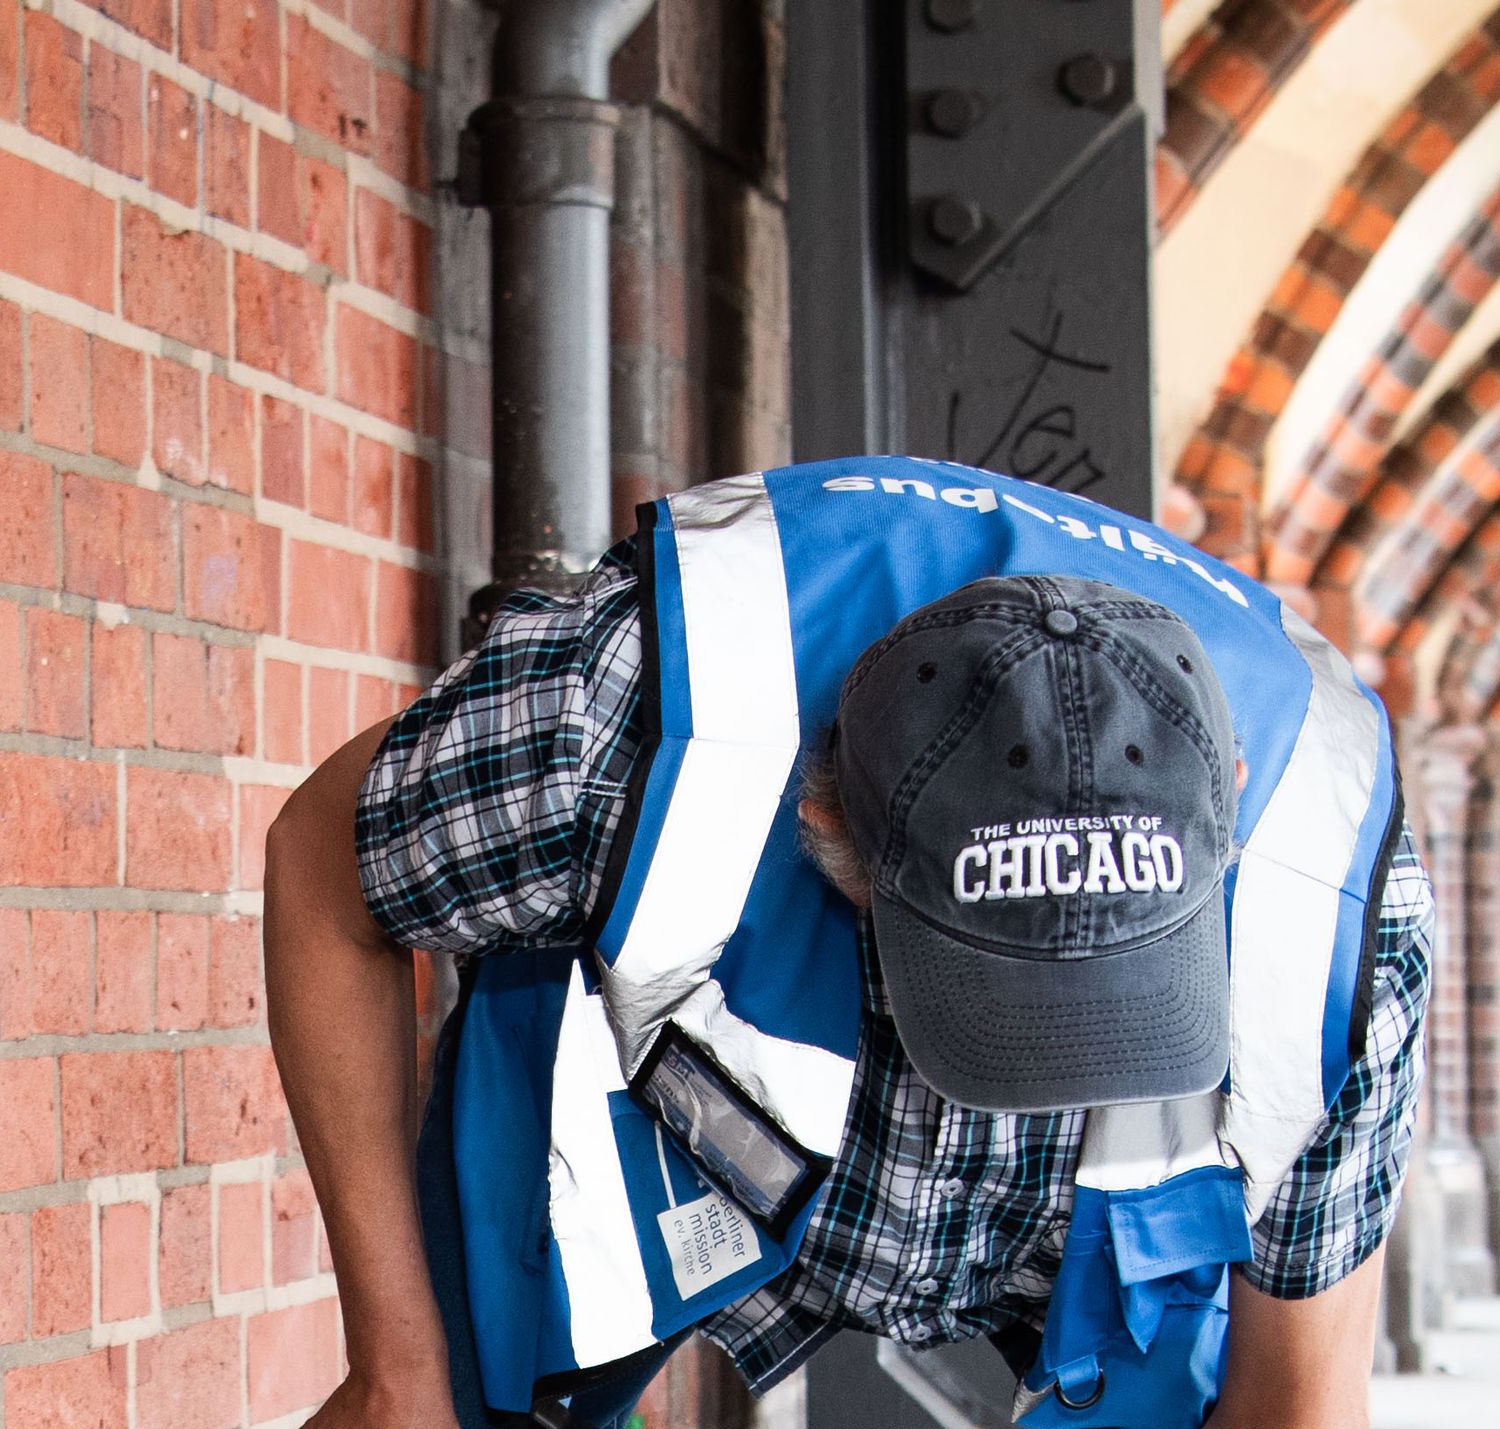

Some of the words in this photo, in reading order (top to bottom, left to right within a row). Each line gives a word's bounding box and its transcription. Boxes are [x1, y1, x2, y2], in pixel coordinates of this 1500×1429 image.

[970, 823, 1011, 841] THE
[1016, 815, 1134, 835] UNIVERSITY
[1138, 816, 1162, 831] OF
[953, 832, 1184, 903] CHICAGO
[673, 1220, 685, 1238] ev.
[681, 1239, 696, 1276] kirche
[689, 1213, 713, 1276] mission
[705, 1203, 729, 1249] stadt
